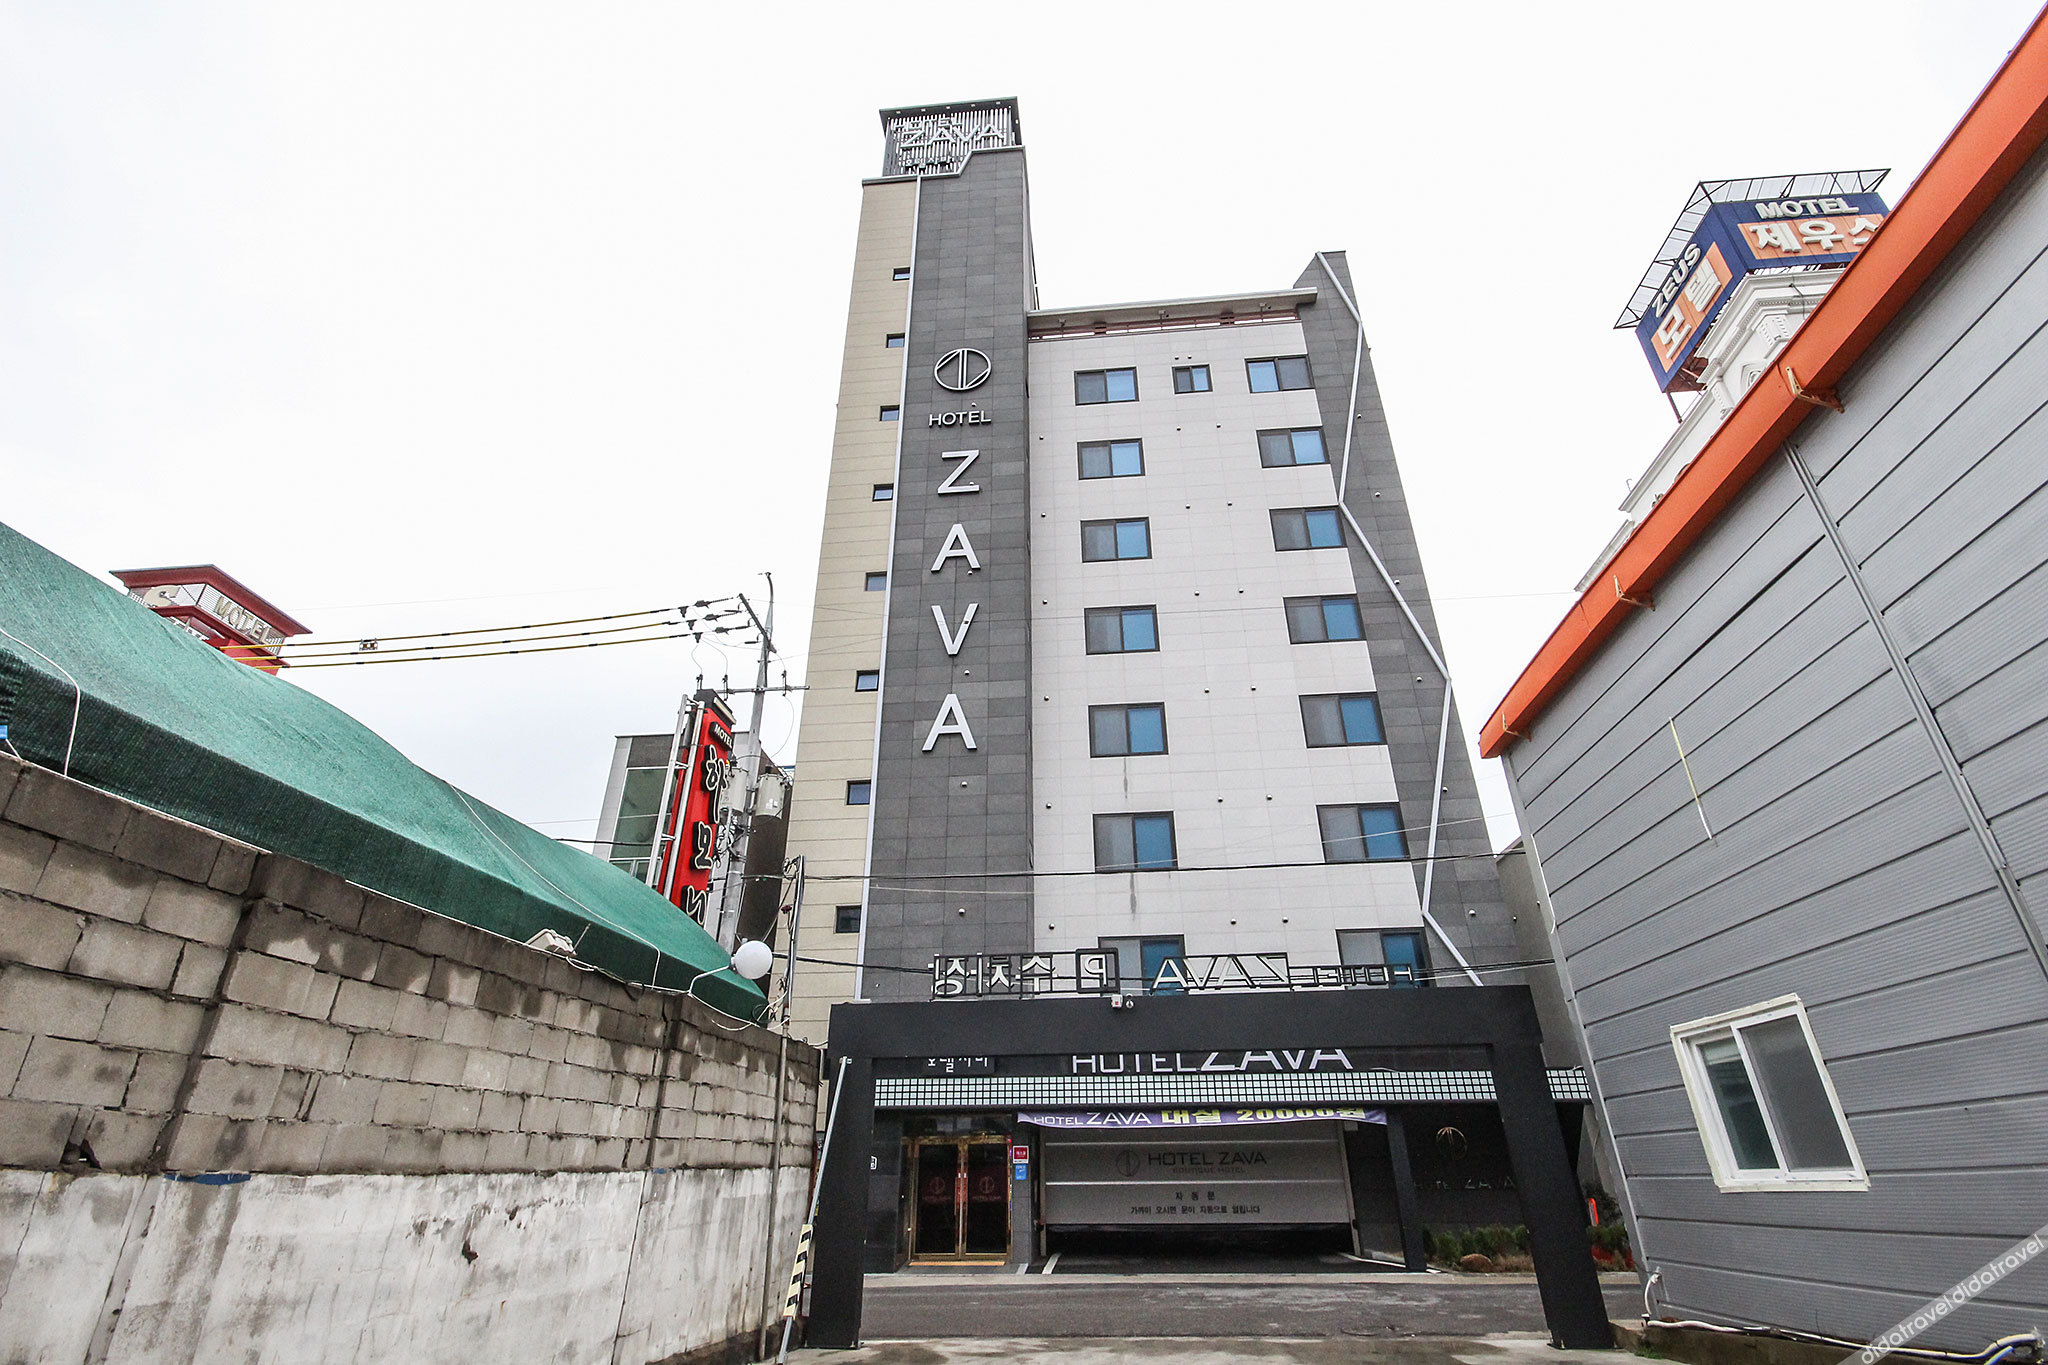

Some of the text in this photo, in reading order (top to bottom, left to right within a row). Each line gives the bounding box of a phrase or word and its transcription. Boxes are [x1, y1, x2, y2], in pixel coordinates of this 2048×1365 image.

[900, 123, 1004, 148] ZAVA
[1754, 197, 1859, 220] MOTEL
[1651, 243, 1702, 318] ZEUS
[1659, 257, 1722, 360] 모텔
[928, 410, 992, 426] HOTEL
[214, 596, 271, 644] MOTEL
[712, 723, 734, 748] MOTEL
[1034, 1112, 1151, 1125] HOTEL ZAVA
[1161, 1110, 1222, 1124] 대실
[1148, 1152, 1268, 1166] HOTEL ZAVA
